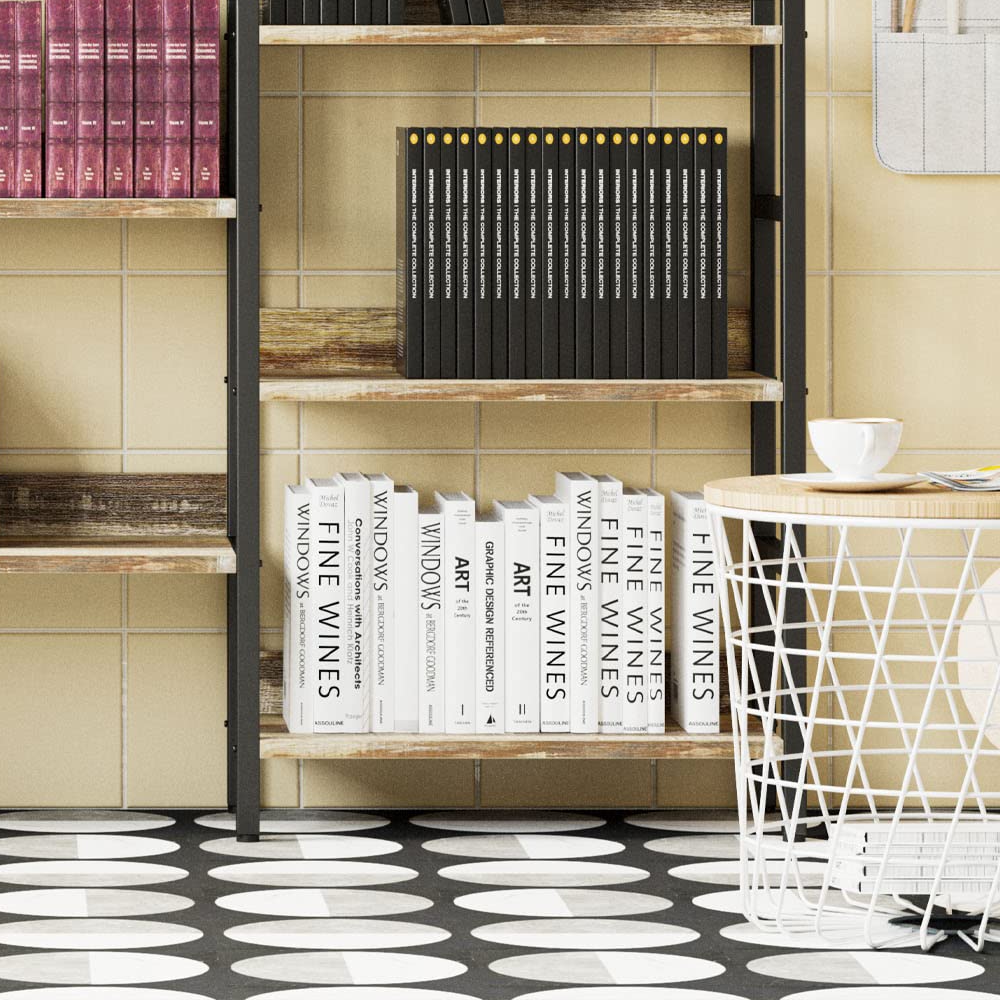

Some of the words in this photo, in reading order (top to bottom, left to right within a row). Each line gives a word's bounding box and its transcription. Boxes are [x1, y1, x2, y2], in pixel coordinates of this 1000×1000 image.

[296, 504, 309, 598] WINDOWS
[319, 523, 339, 585] FINE
[374, 491, 387, 590] WINDOWS
[421, 523, 440, 609] WINDOWS
[486, 541, 494, 585] GRAPHIC
[546, 537, 565, 595] FINE
[577, 491, 591, 590] WINDOWS
[601, 519, 618, 583] FINE
[627, 527, 643, 590] FINE
[650, 531, 662, 591] FINE
[693, 534, 713, 594] FINE
[455, 557, 469, 592] ART
[486, 589, 494, 624] DESIGN
[514, 563, 530, 596] ART
[319, 602, 340, 697] WINES
[426, 620, 436, 654] BERGDORF
[486, 628, 494, 692] REFERENCED
[546, 610, 565, 699] WINES
[601, 599, 619, 697] WINES
[627, 606, 643, 703] WINES
[650, 607, 662, 700] WINES
[693, 608, 714, 700] WINES
[426, 656, 435, 692] GOODMAN
